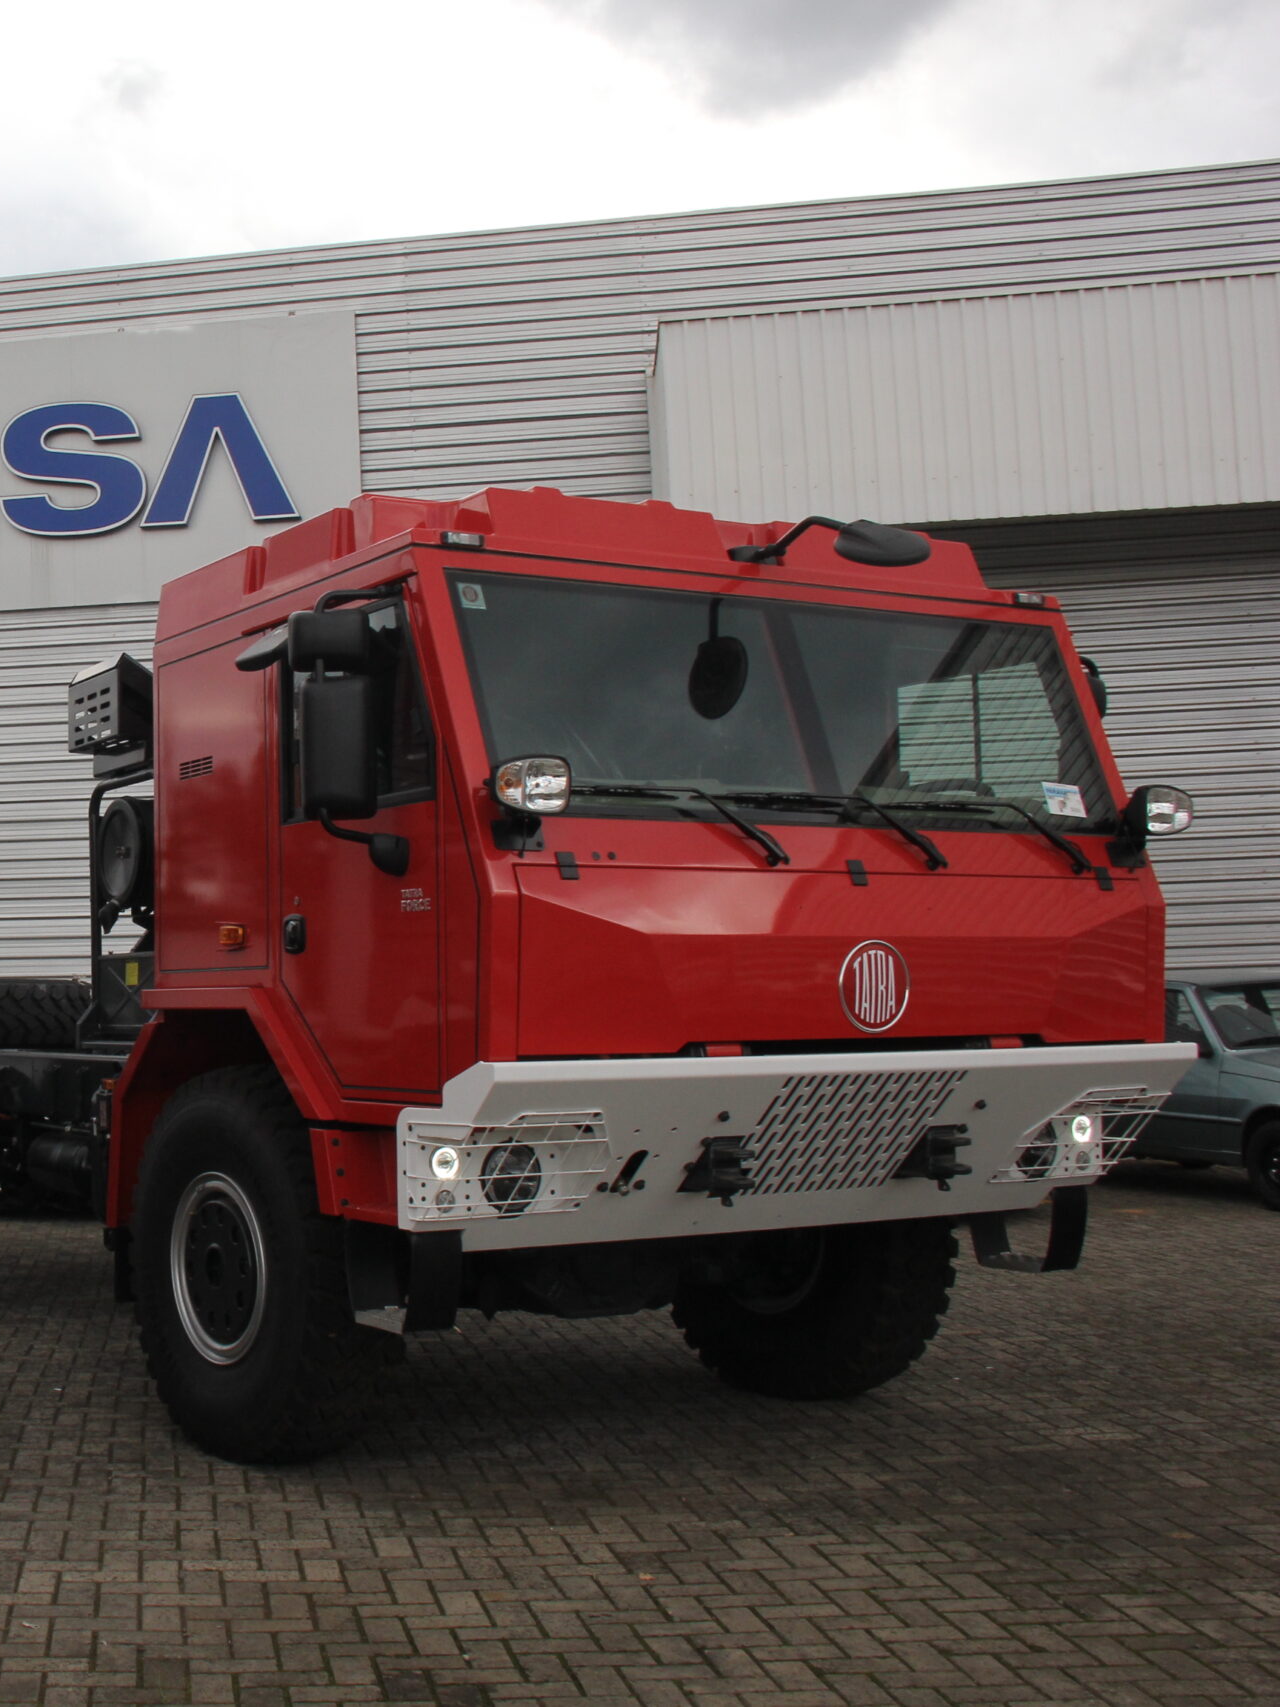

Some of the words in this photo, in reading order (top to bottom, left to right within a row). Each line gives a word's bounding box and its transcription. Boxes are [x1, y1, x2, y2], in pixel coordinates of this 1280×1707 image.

[401, 888, 424, 898] TATRA
[401, 898, 431, 912] FORCE
[853, 949, 896, 1024] TATRA
